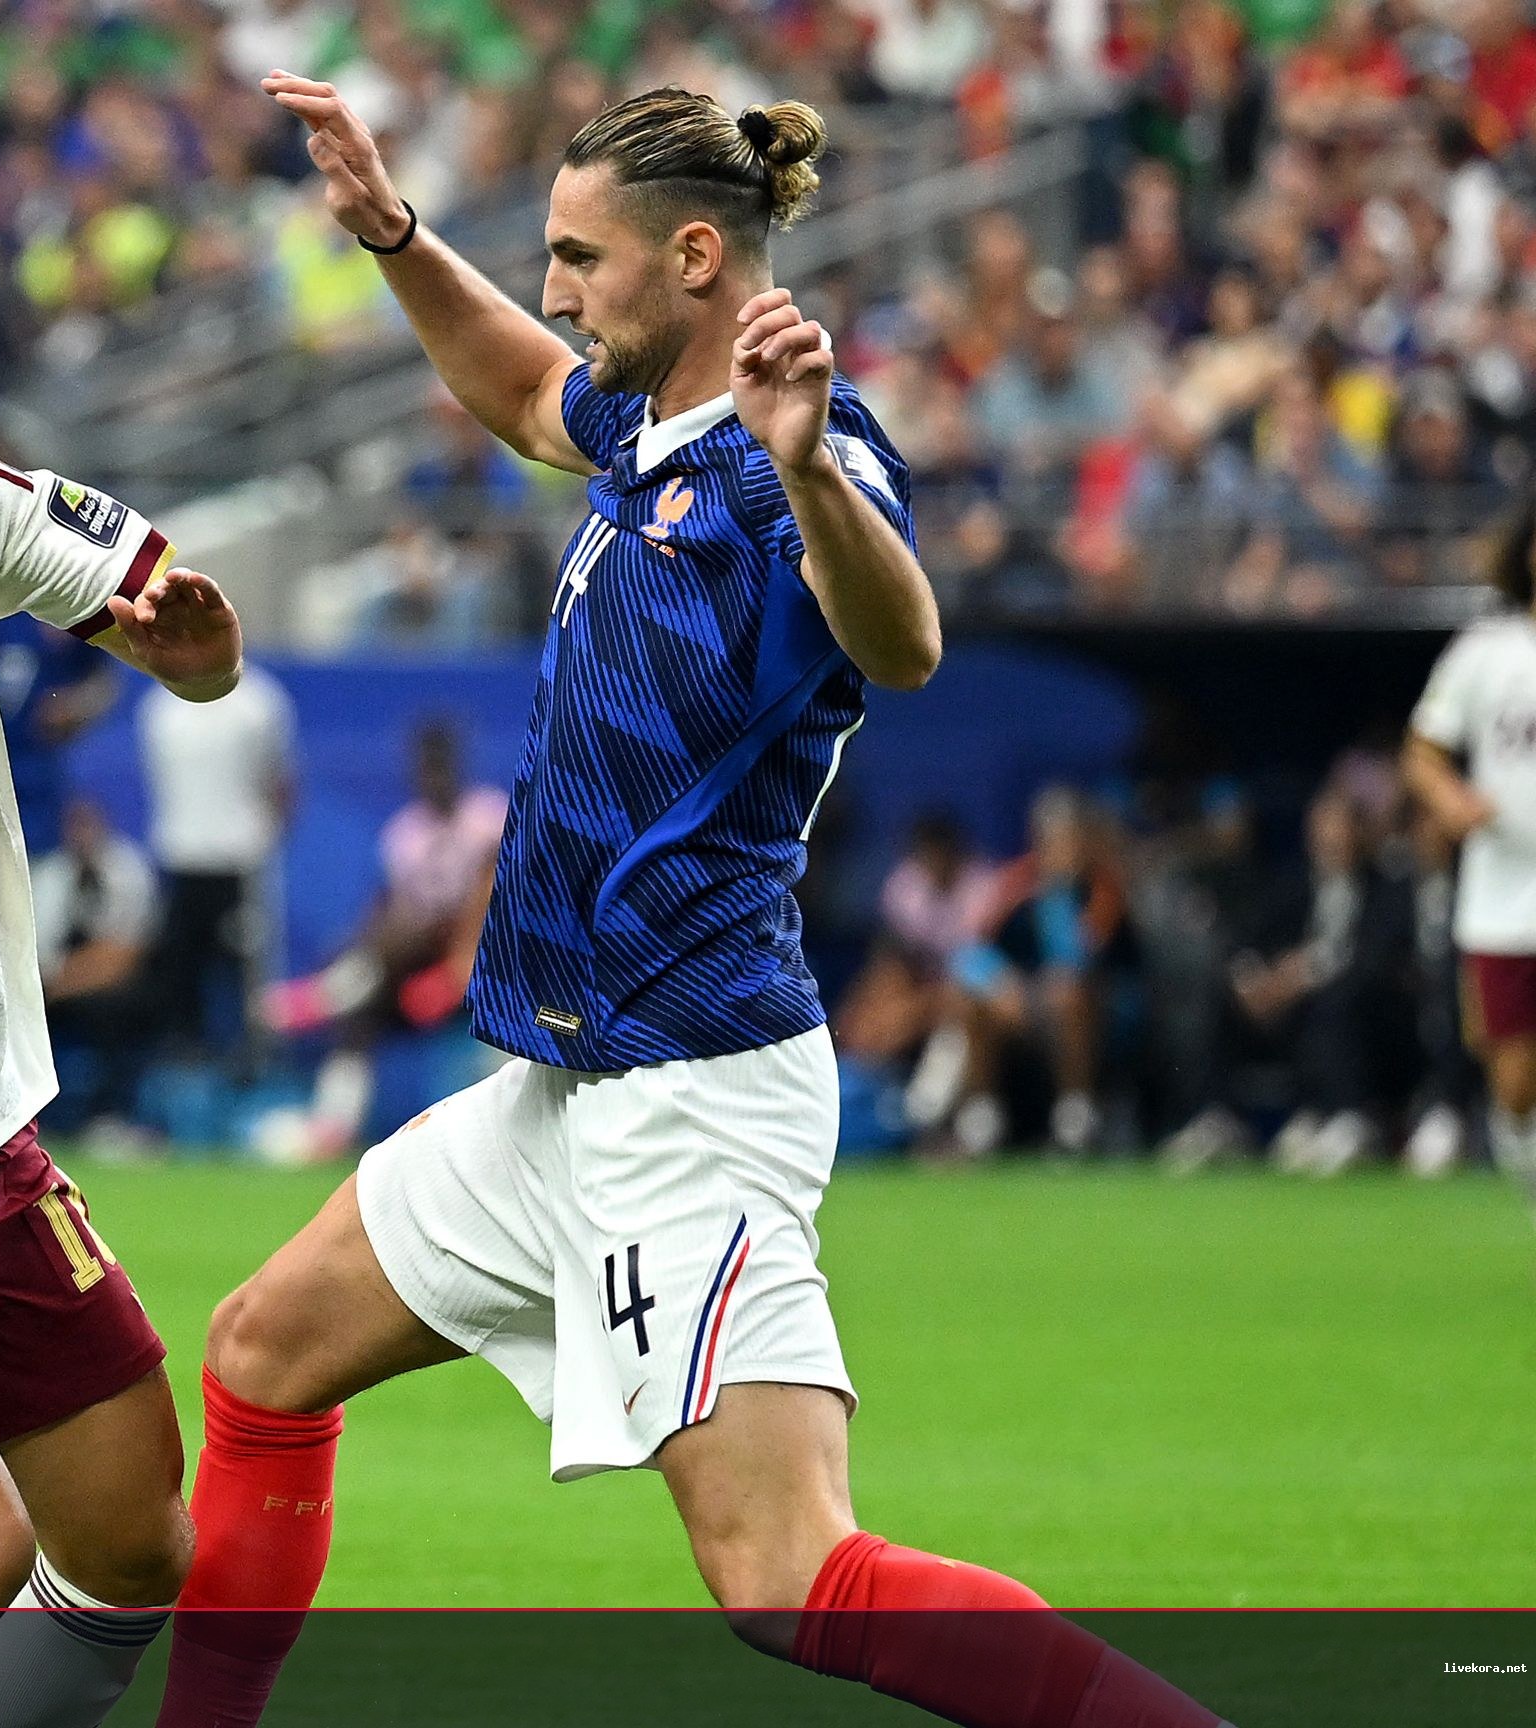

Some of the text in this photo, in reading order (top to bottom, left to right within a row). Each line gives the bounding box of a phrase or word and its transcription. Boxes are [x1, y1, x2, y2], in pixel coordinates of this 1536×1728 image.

[89, 494, 114, 536] EDUCAT
[551, 512, 618, 629] 14
[598, 1243, 655, 1357] 4
